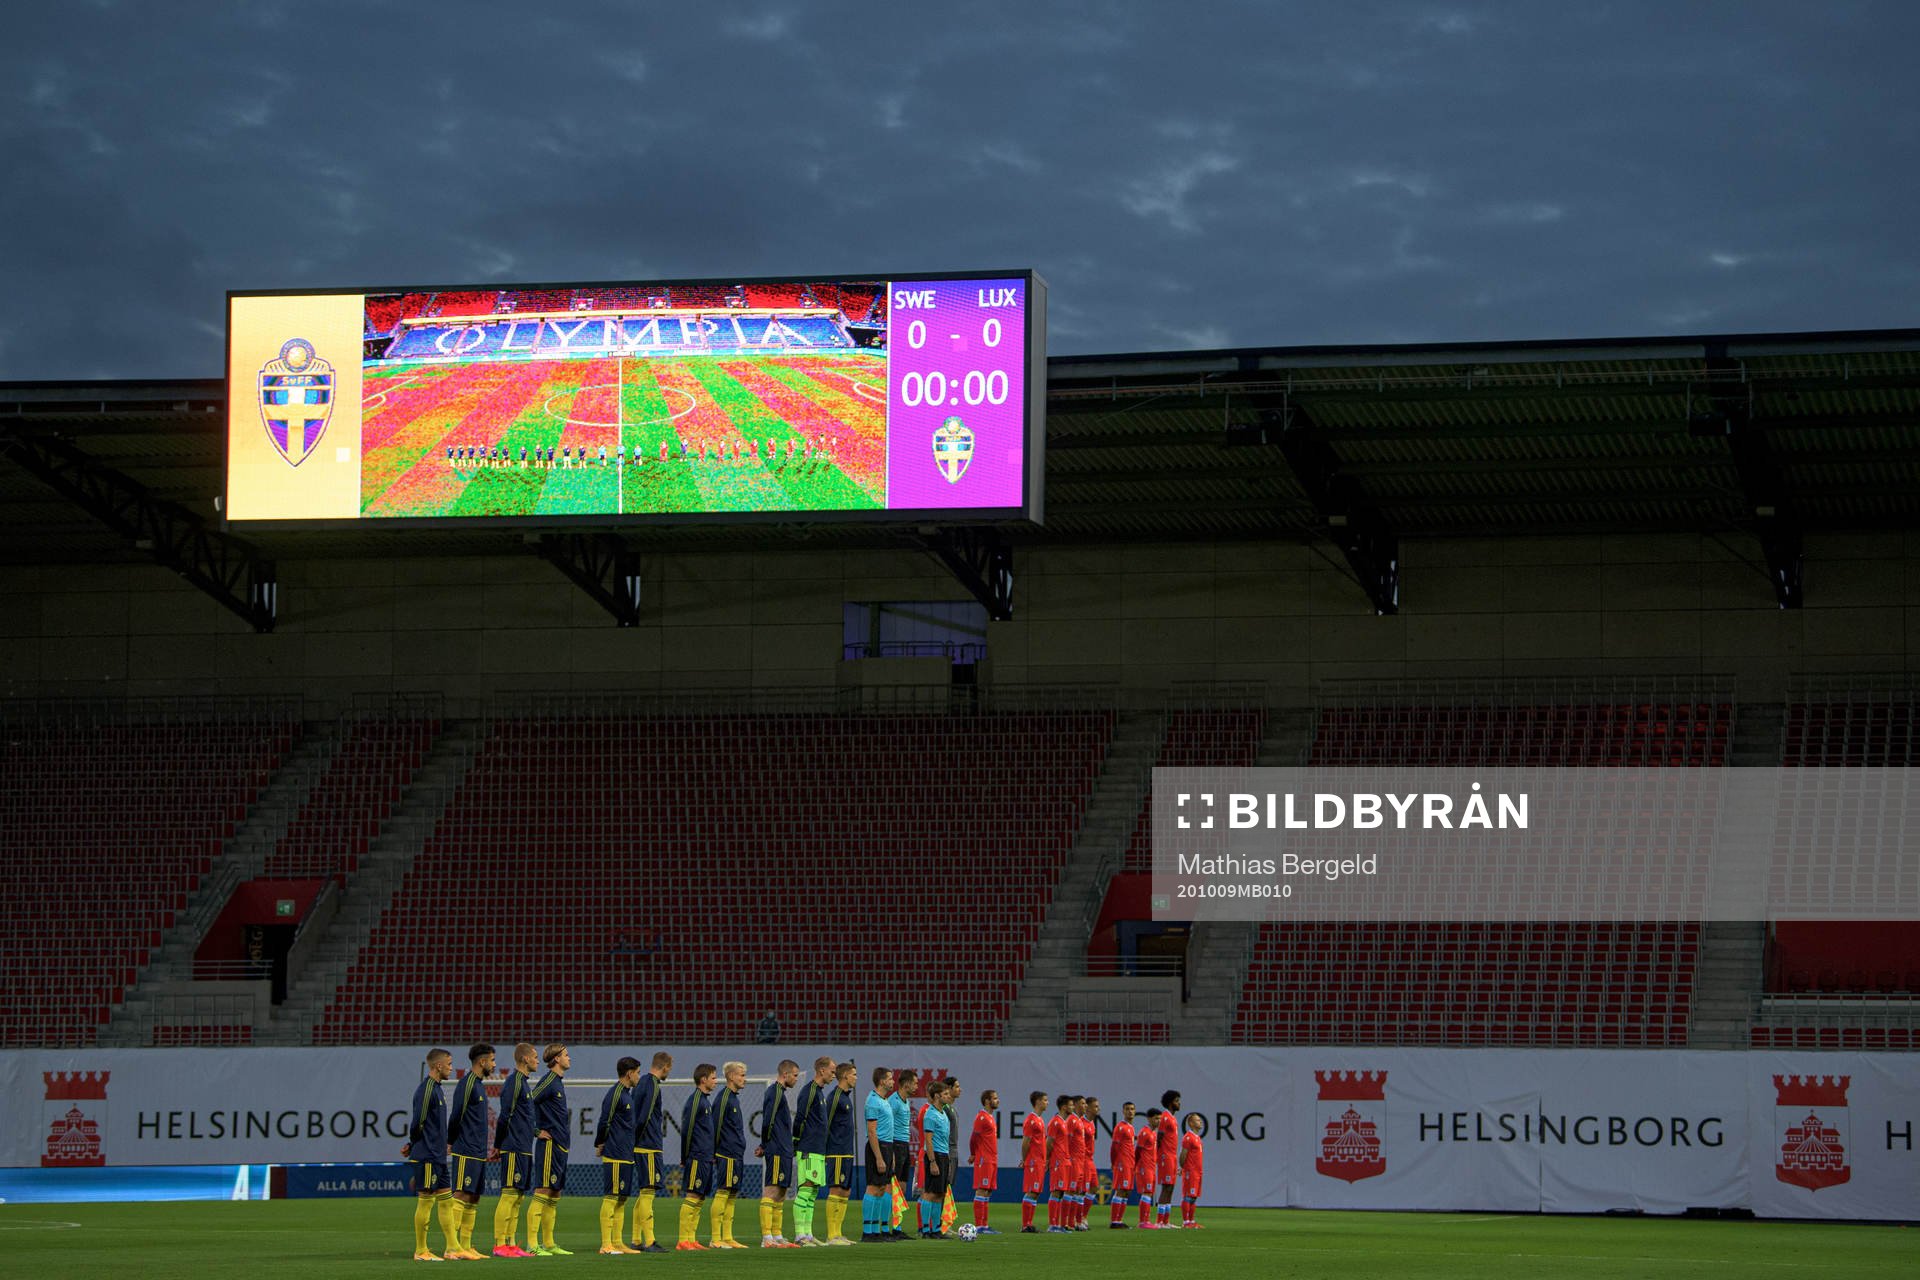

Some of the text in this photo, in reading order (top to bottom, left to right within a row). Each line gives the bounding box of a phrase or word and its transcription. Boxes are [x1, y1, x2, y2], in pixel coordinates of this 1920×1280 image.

[894, 288, 1017, 310] SWE LUX
[434, 318, 813, 353] OLYMPIA
[907, 320, 927, 349] 0
[982, 318, 1002, 347] 0
[901, 369, 1009, 406] 00:00
[137, 1110, 409, 1140] HELSINGBORG
[1419, 1111, 1725, 1148] HELSINGBORG
[317, 1179, 404, 1191] ALLA ÄR OLIKA
